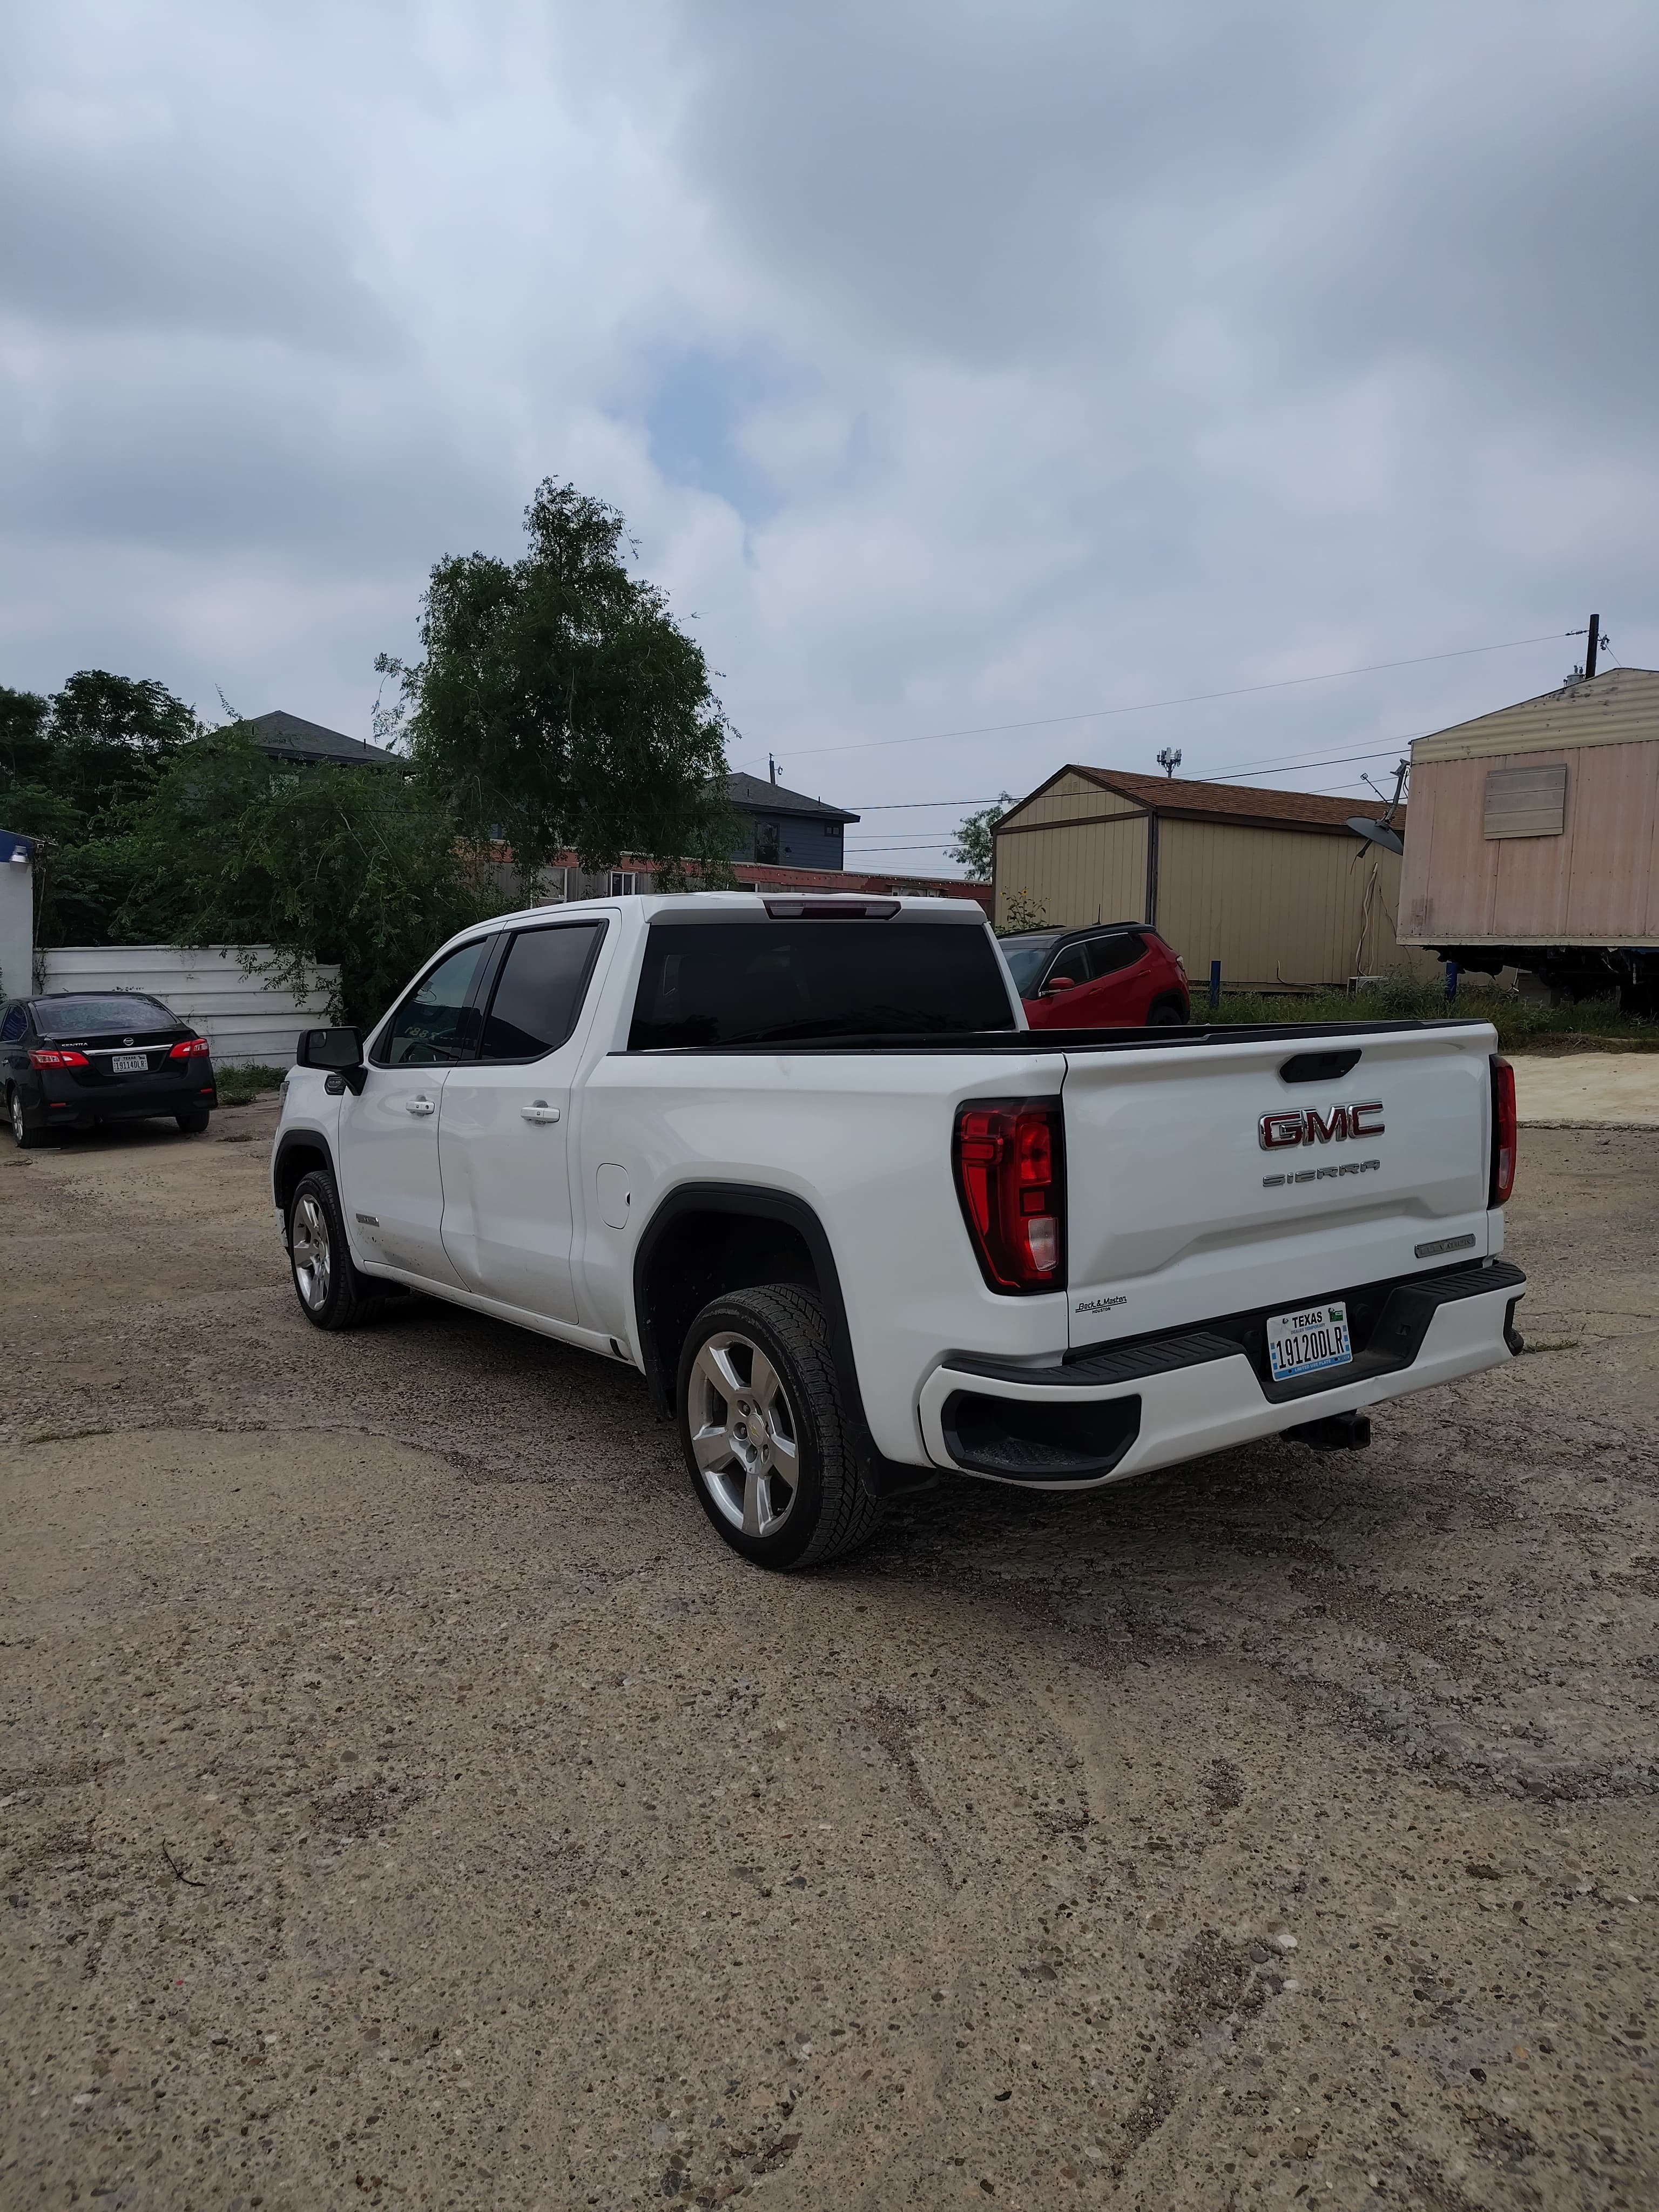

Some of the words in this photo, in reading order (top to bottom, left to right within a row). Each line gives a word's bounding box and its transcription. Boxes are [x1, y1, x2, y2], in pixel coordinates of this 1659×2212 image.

[116, 1060, 145, 1070] 19114DLR
[1258, 1100, 1385, 1150] GMC
[1263, 1159, 1380, 1187] SIERRA
[1078, 1301, 1094, 1310] Beck
[1103, 1296, 1127, 1305] Masten
[1292, 1311, 1323, 1328] TEXAS
[1276, 1326, 1344, 1369] 19120DLR
